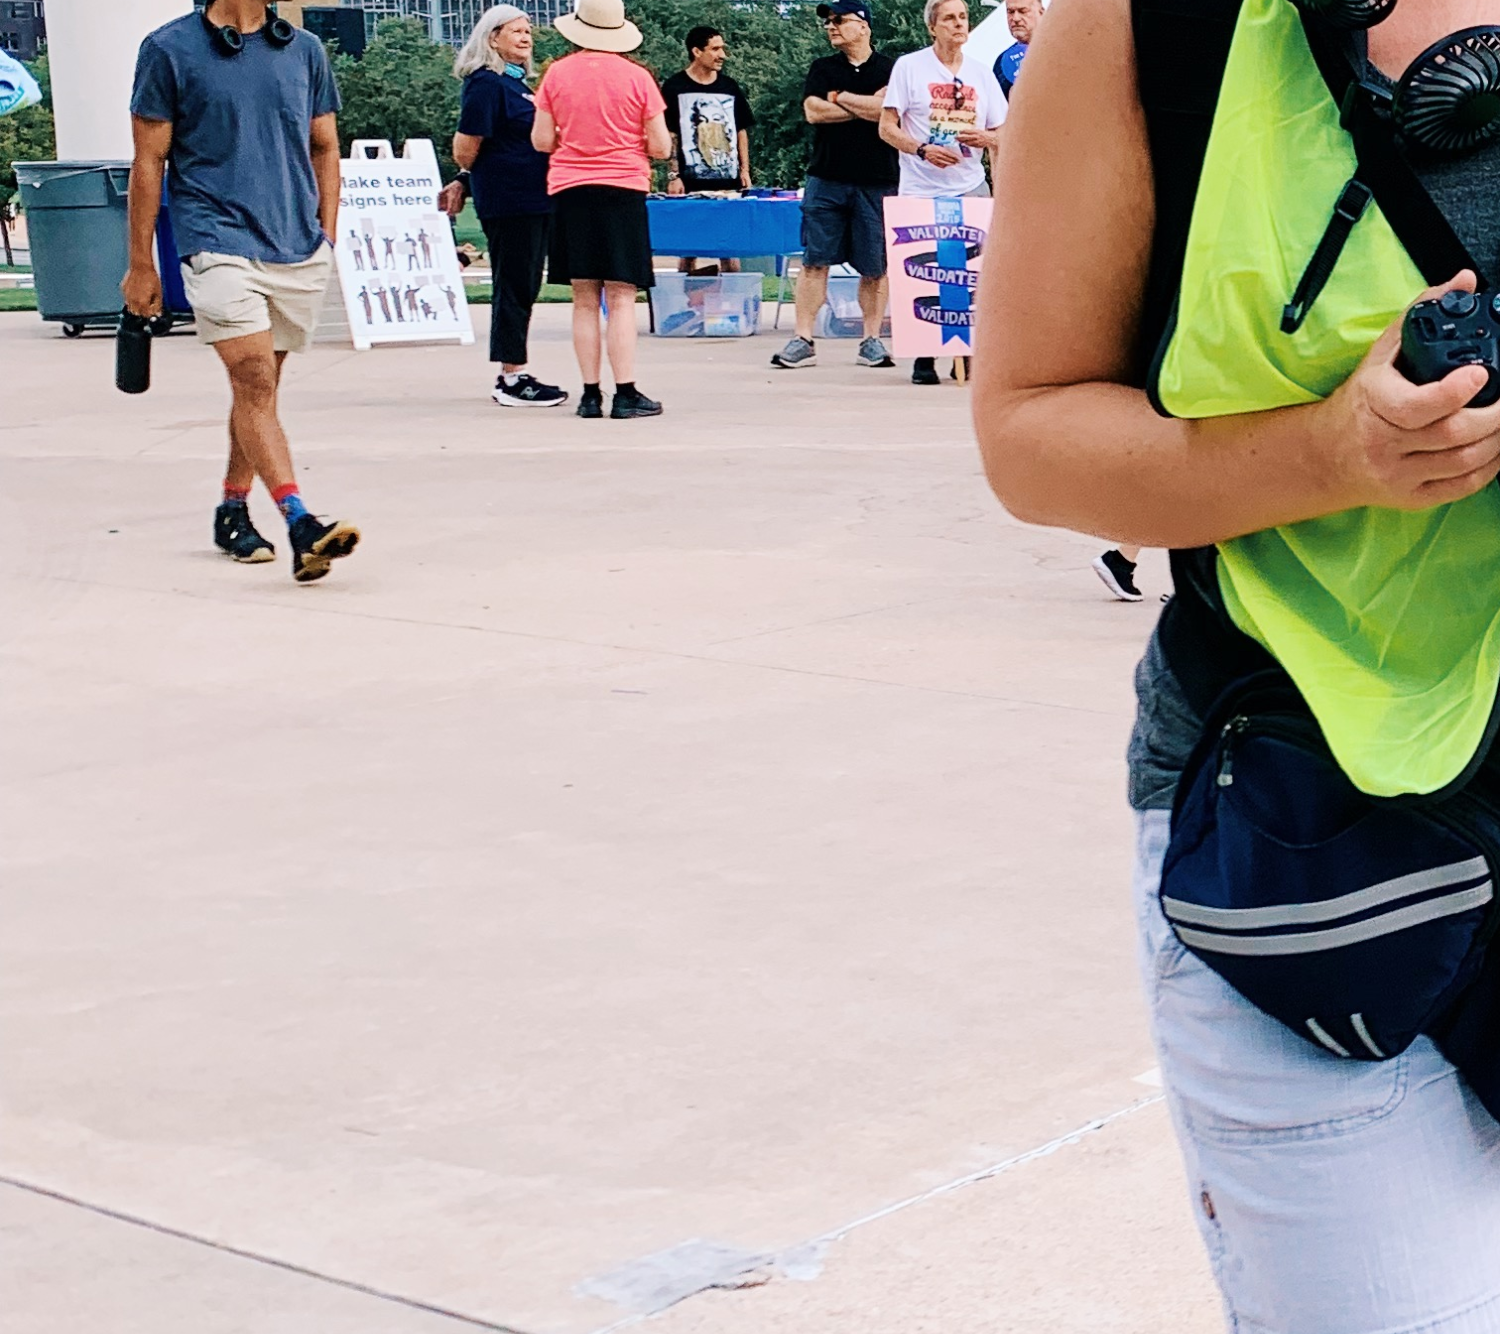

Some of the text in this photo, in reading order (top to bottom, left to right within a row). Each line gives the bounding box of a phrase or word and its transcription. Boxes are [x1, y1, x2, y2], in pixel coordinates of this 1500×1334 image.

[387, 176, 433, 188] team
[340, 194, 432, 209] signs here
